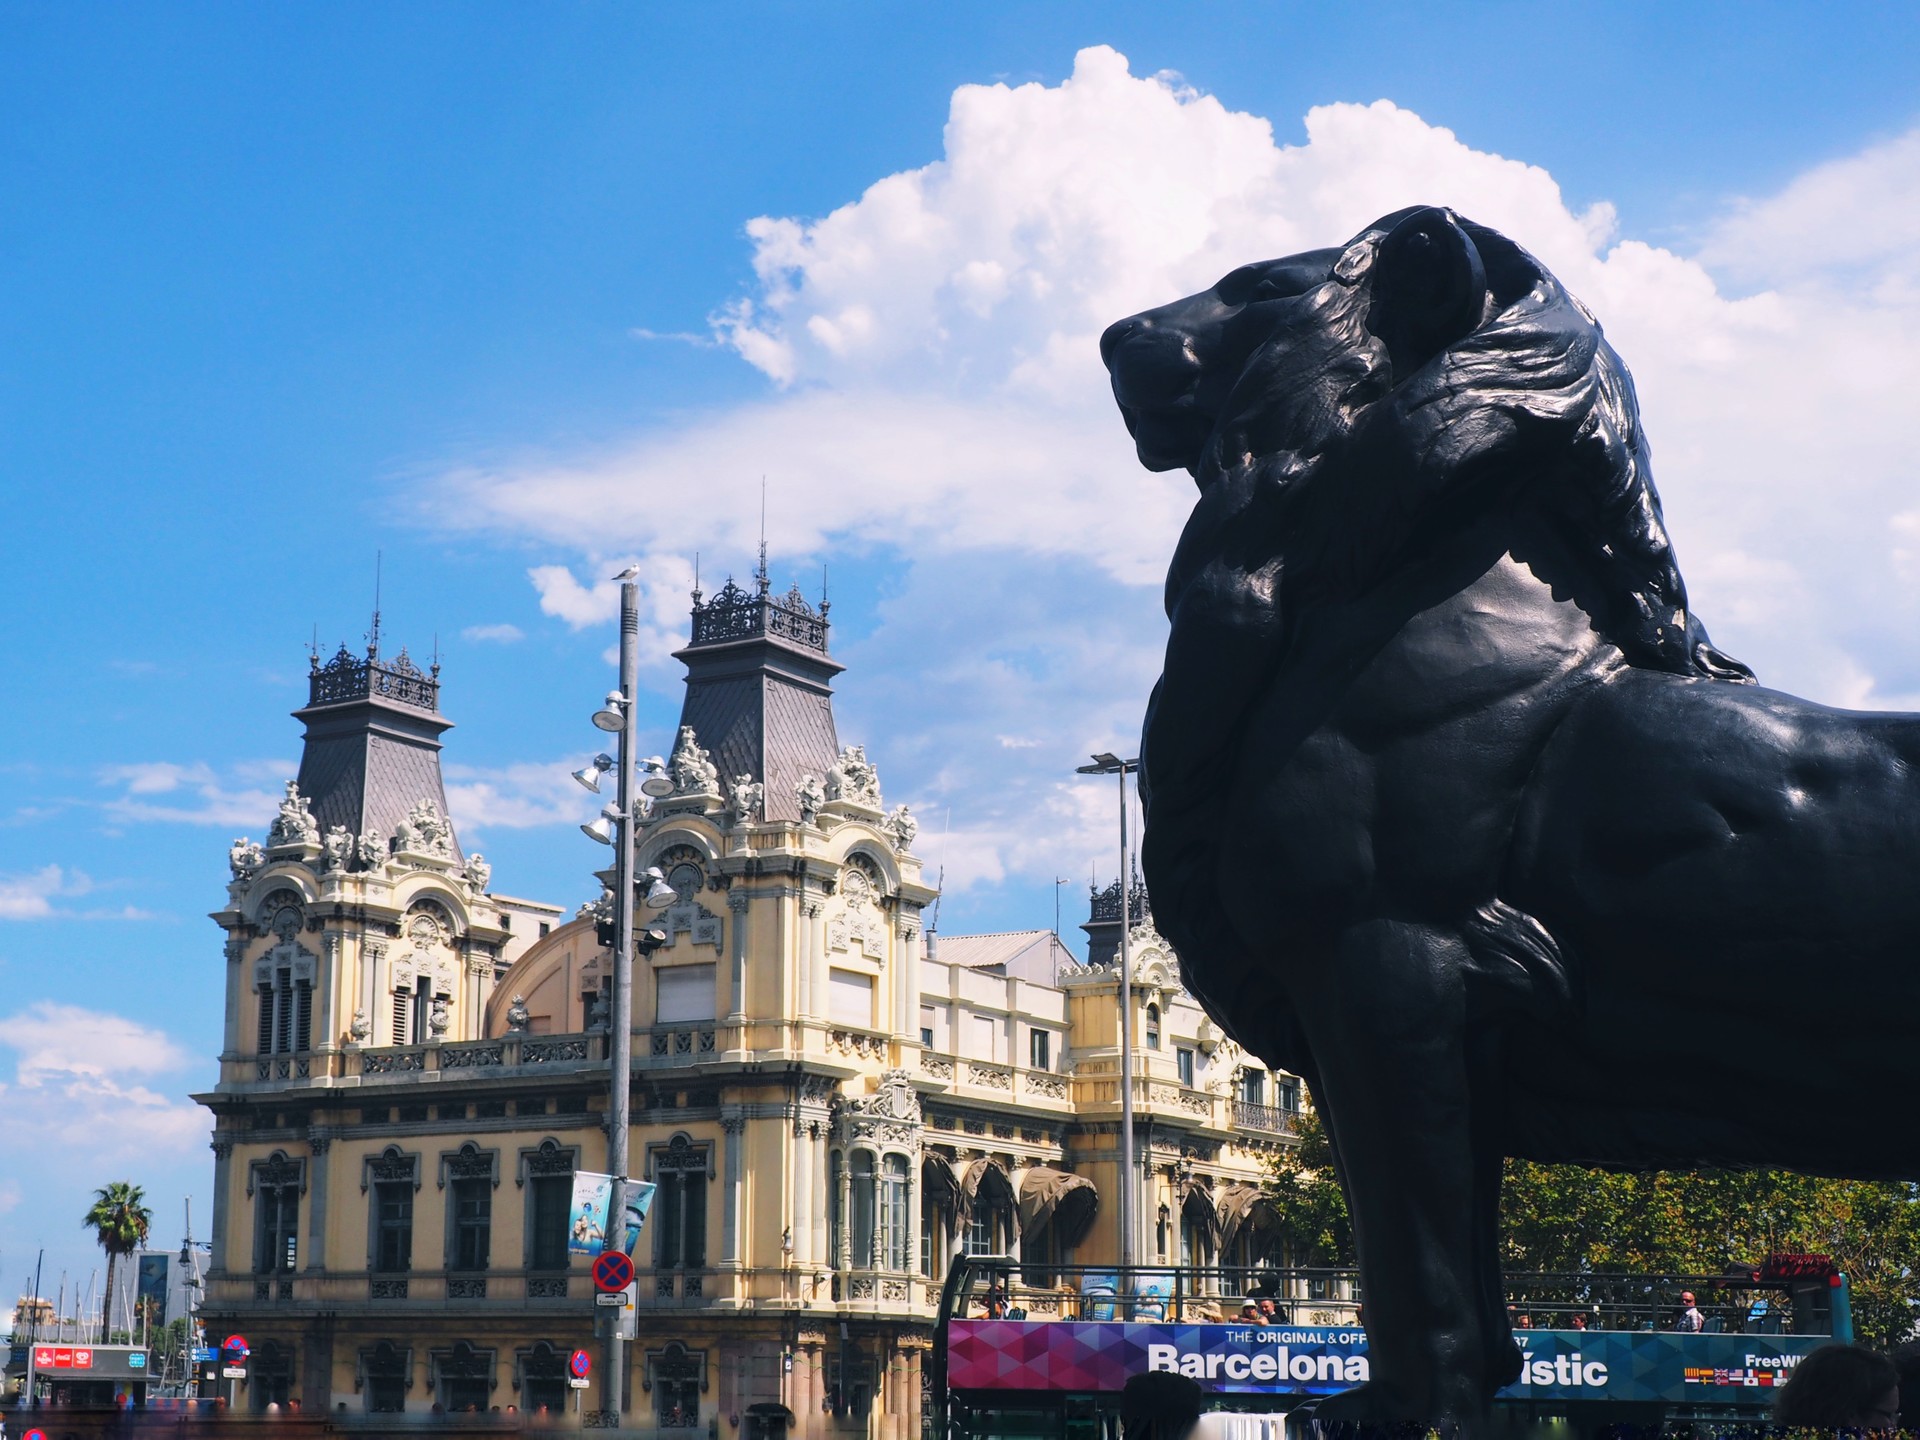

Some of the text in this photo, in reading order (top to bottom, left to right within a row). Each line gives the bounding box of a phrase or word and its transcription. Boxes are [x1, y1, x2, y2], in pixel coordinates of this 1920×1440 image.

[1225, 1331, 1368, 1345] THE ORIGINAL & OFF
[1148, 1344, 1370, 1382] Barcelona
[1521, 1352, 1609, 1387] ístic
[1745, 1354, 1807, 1368] FreeWI
